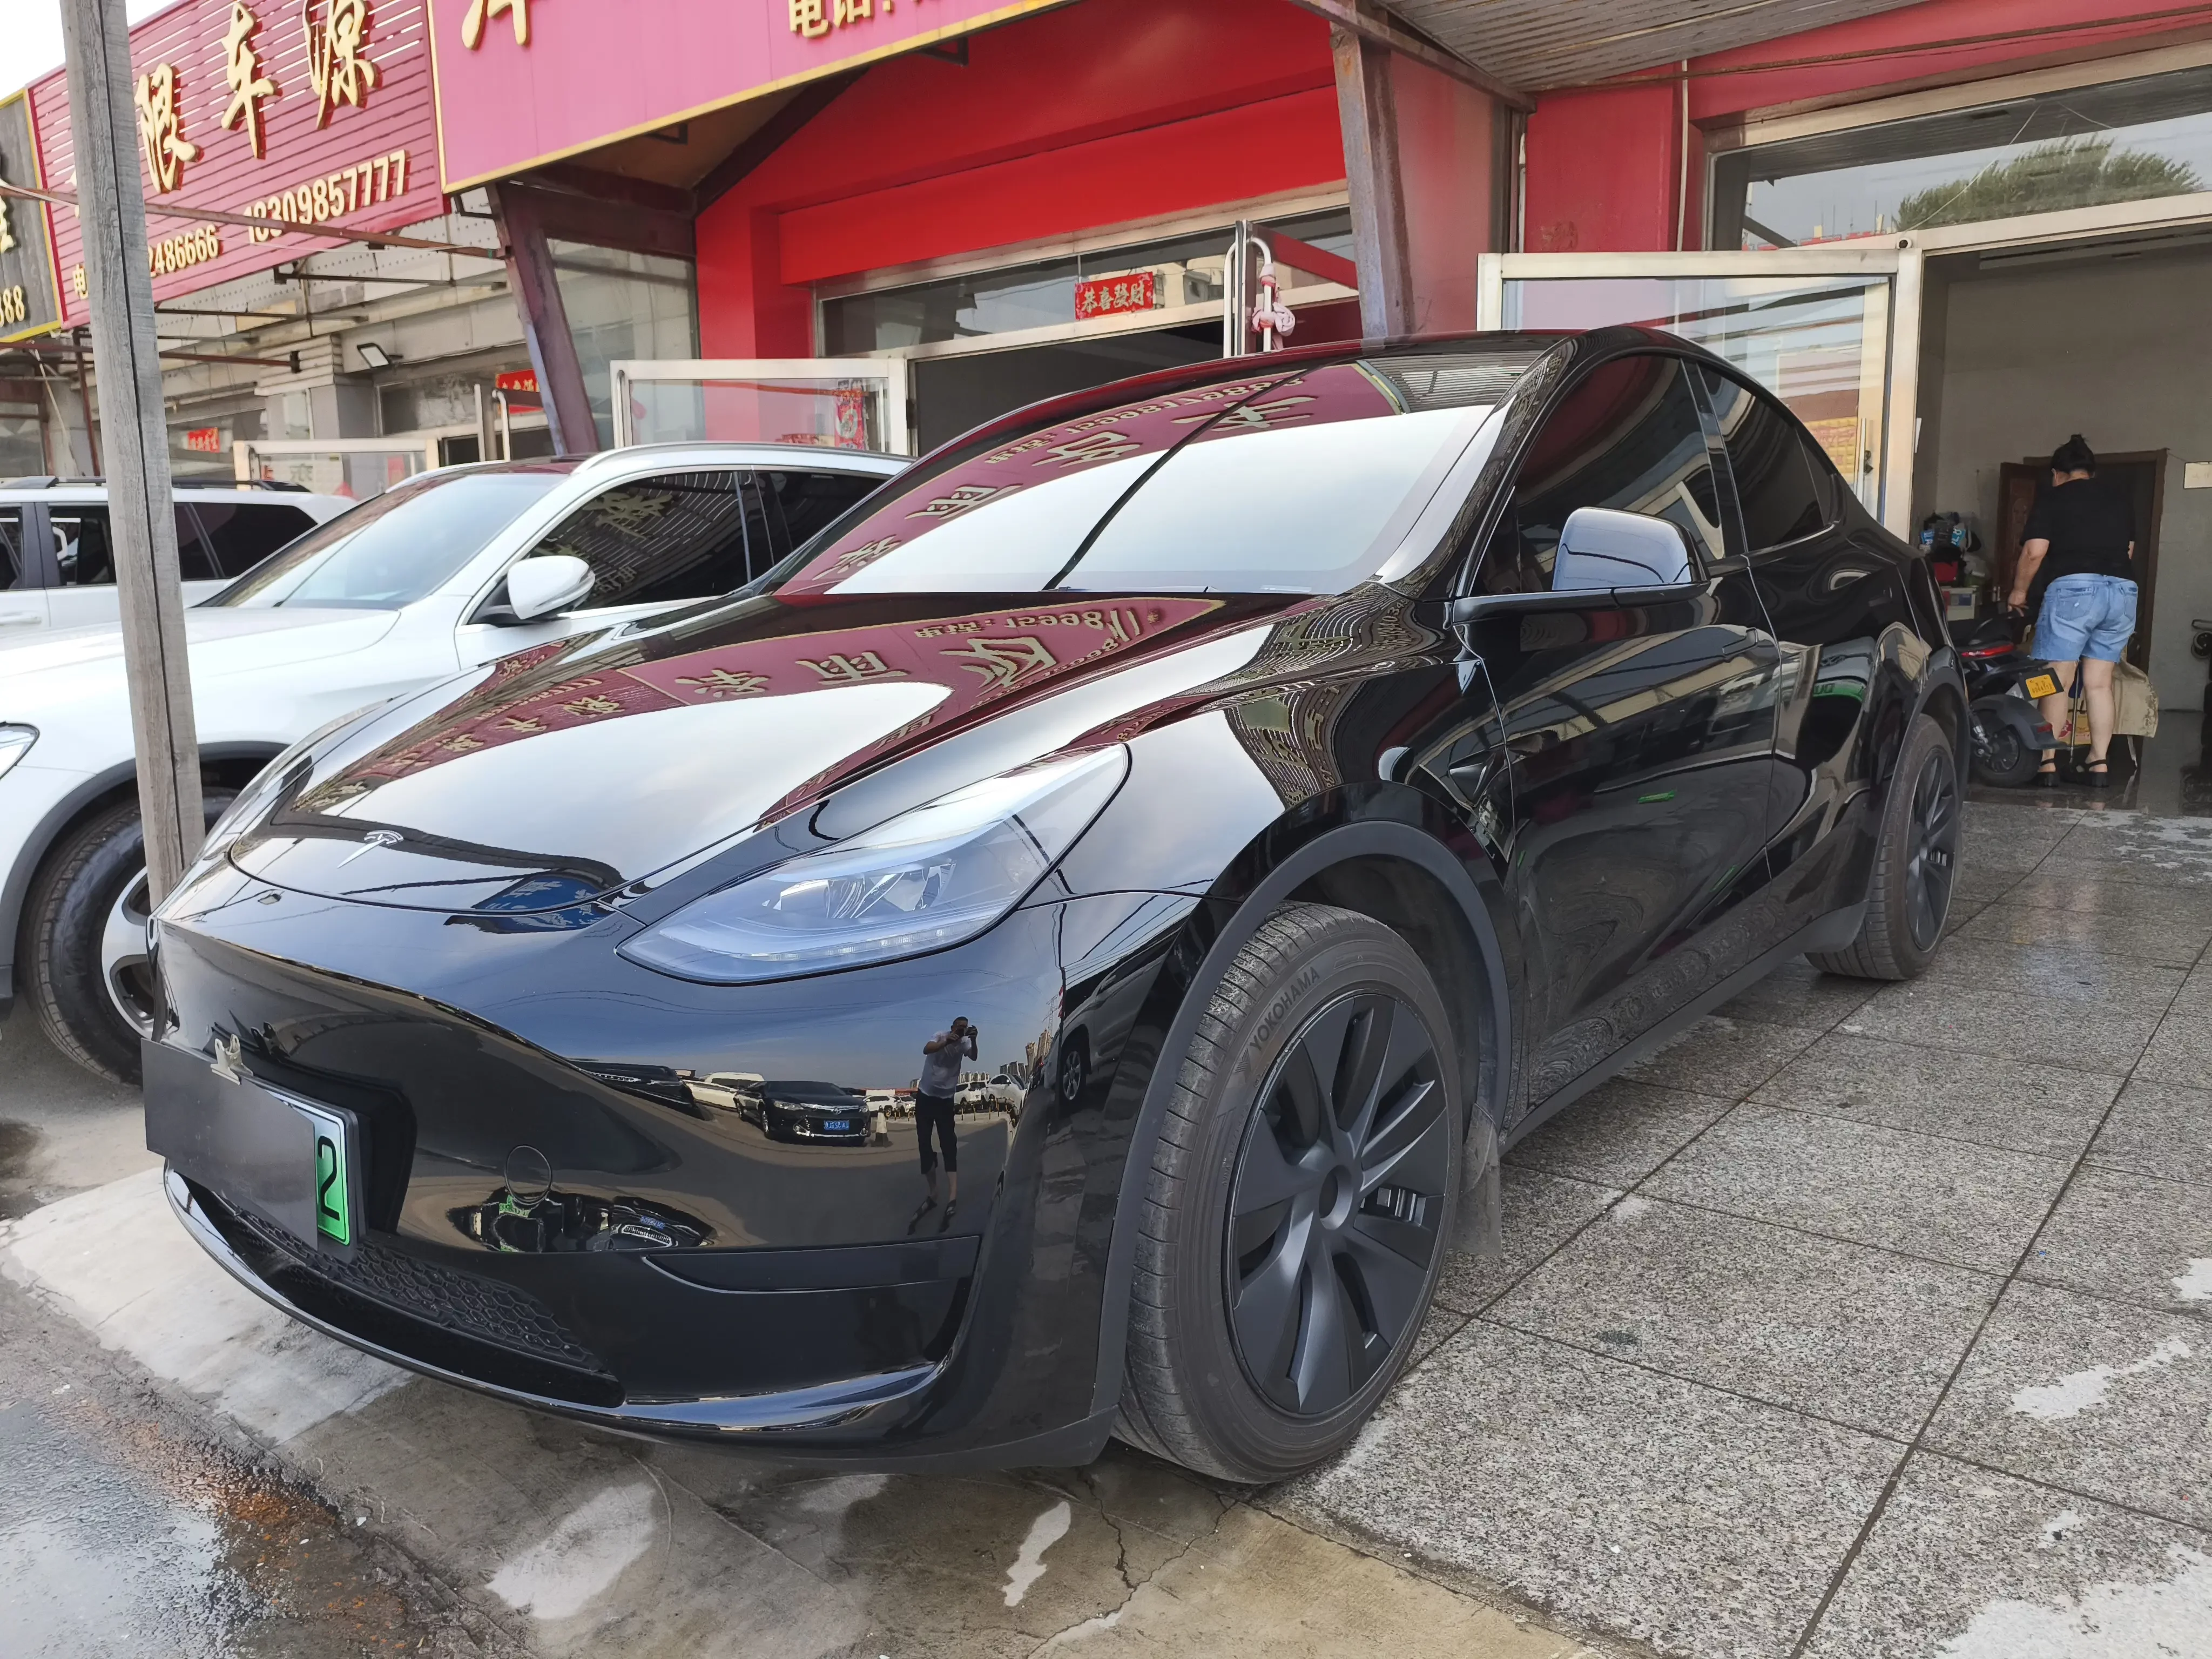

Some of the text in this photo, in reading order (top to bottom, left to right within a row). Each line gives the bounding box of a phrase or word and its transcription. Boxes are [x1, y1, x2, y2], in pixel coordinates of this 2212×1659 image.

[244, 149, 406, 244] 18309857777
[1249, 966, 1320, 1053] YOKOHAMA
[318, 1135, 340, 1222] 2
